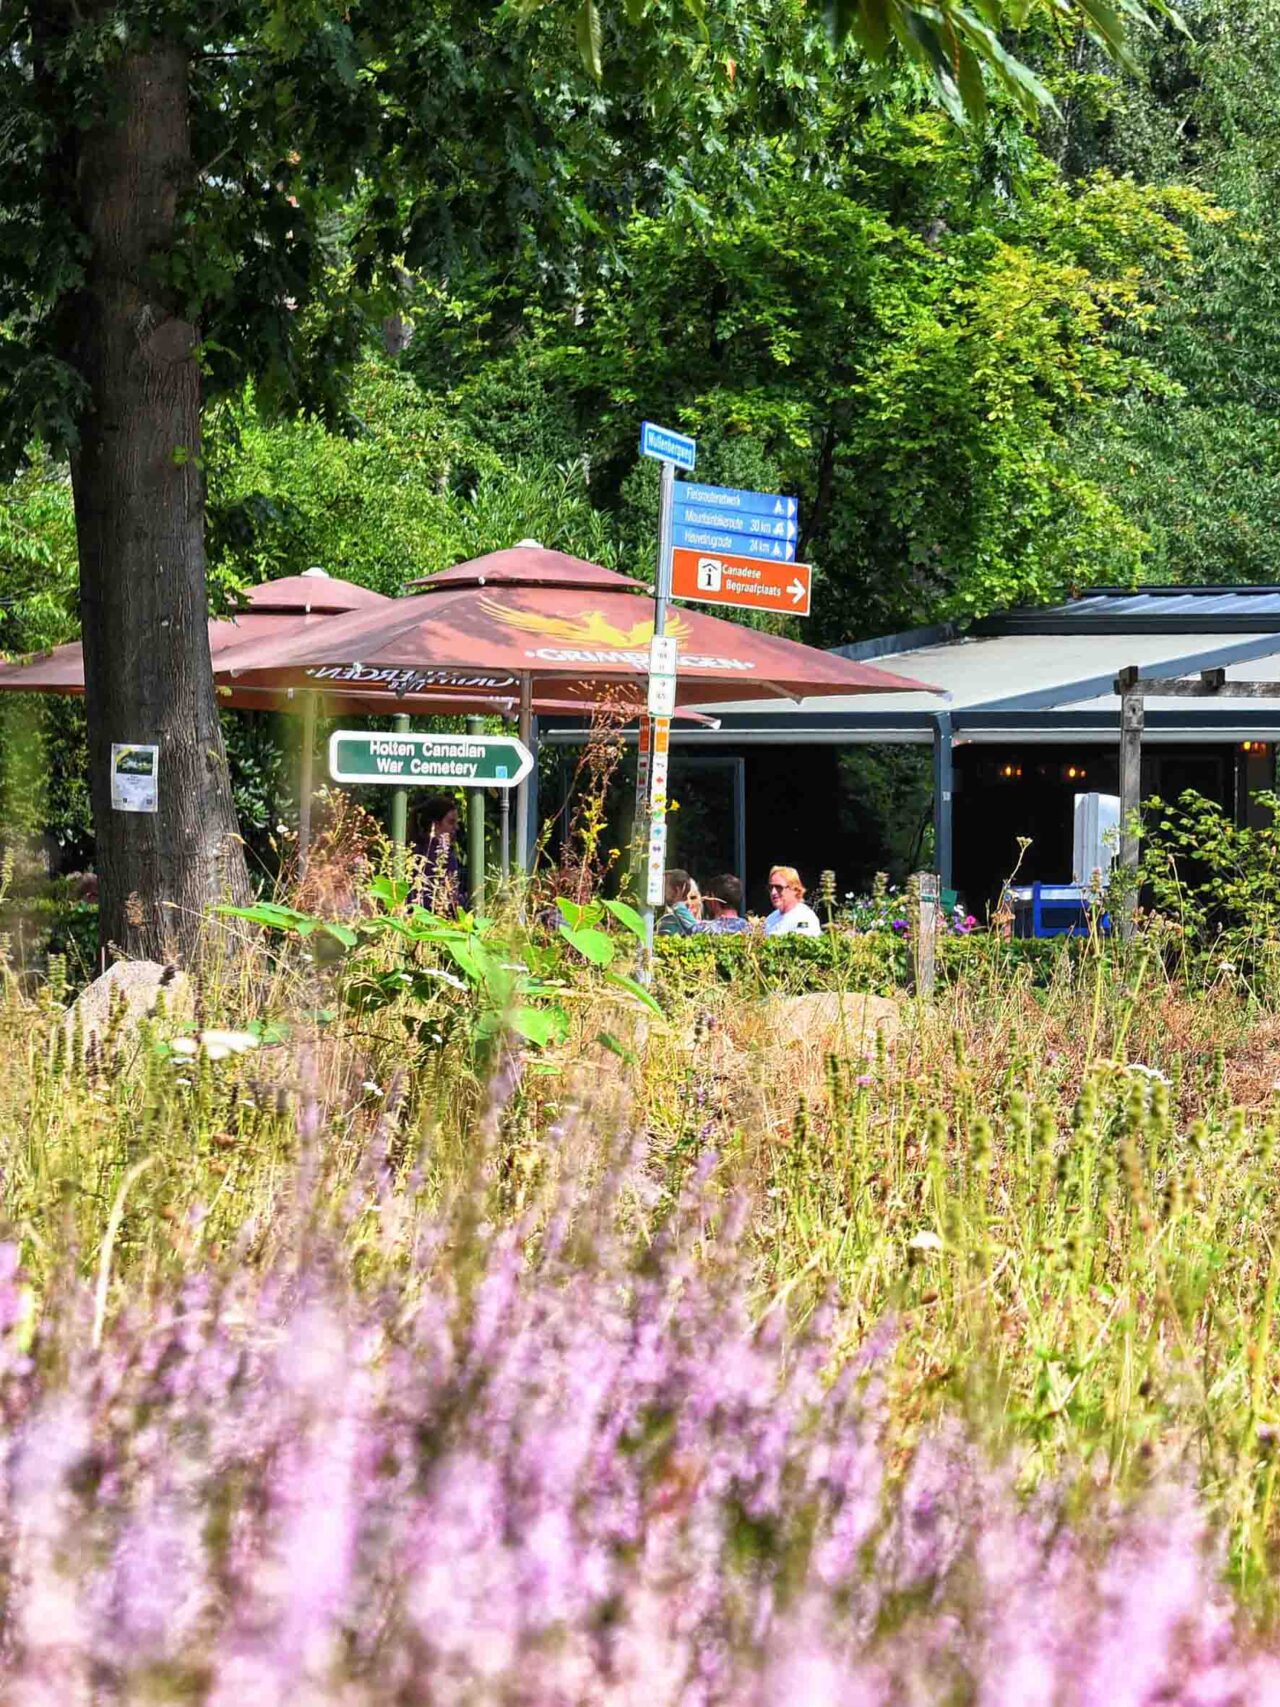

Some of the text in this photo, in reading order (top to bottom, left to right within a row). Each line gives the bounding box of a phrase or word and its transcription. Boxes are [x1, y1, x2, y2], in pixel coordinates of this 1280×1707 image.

[761, 520, 771, 533] km
[759, 540, 770, 553] km
[722, 564, 761, 579] Canadese
[726, 578, 781, 597] Begraafplaats
[369, 741, 486, 758] Holten Canadian
[377, 758, 478, 778] War Cemetery
